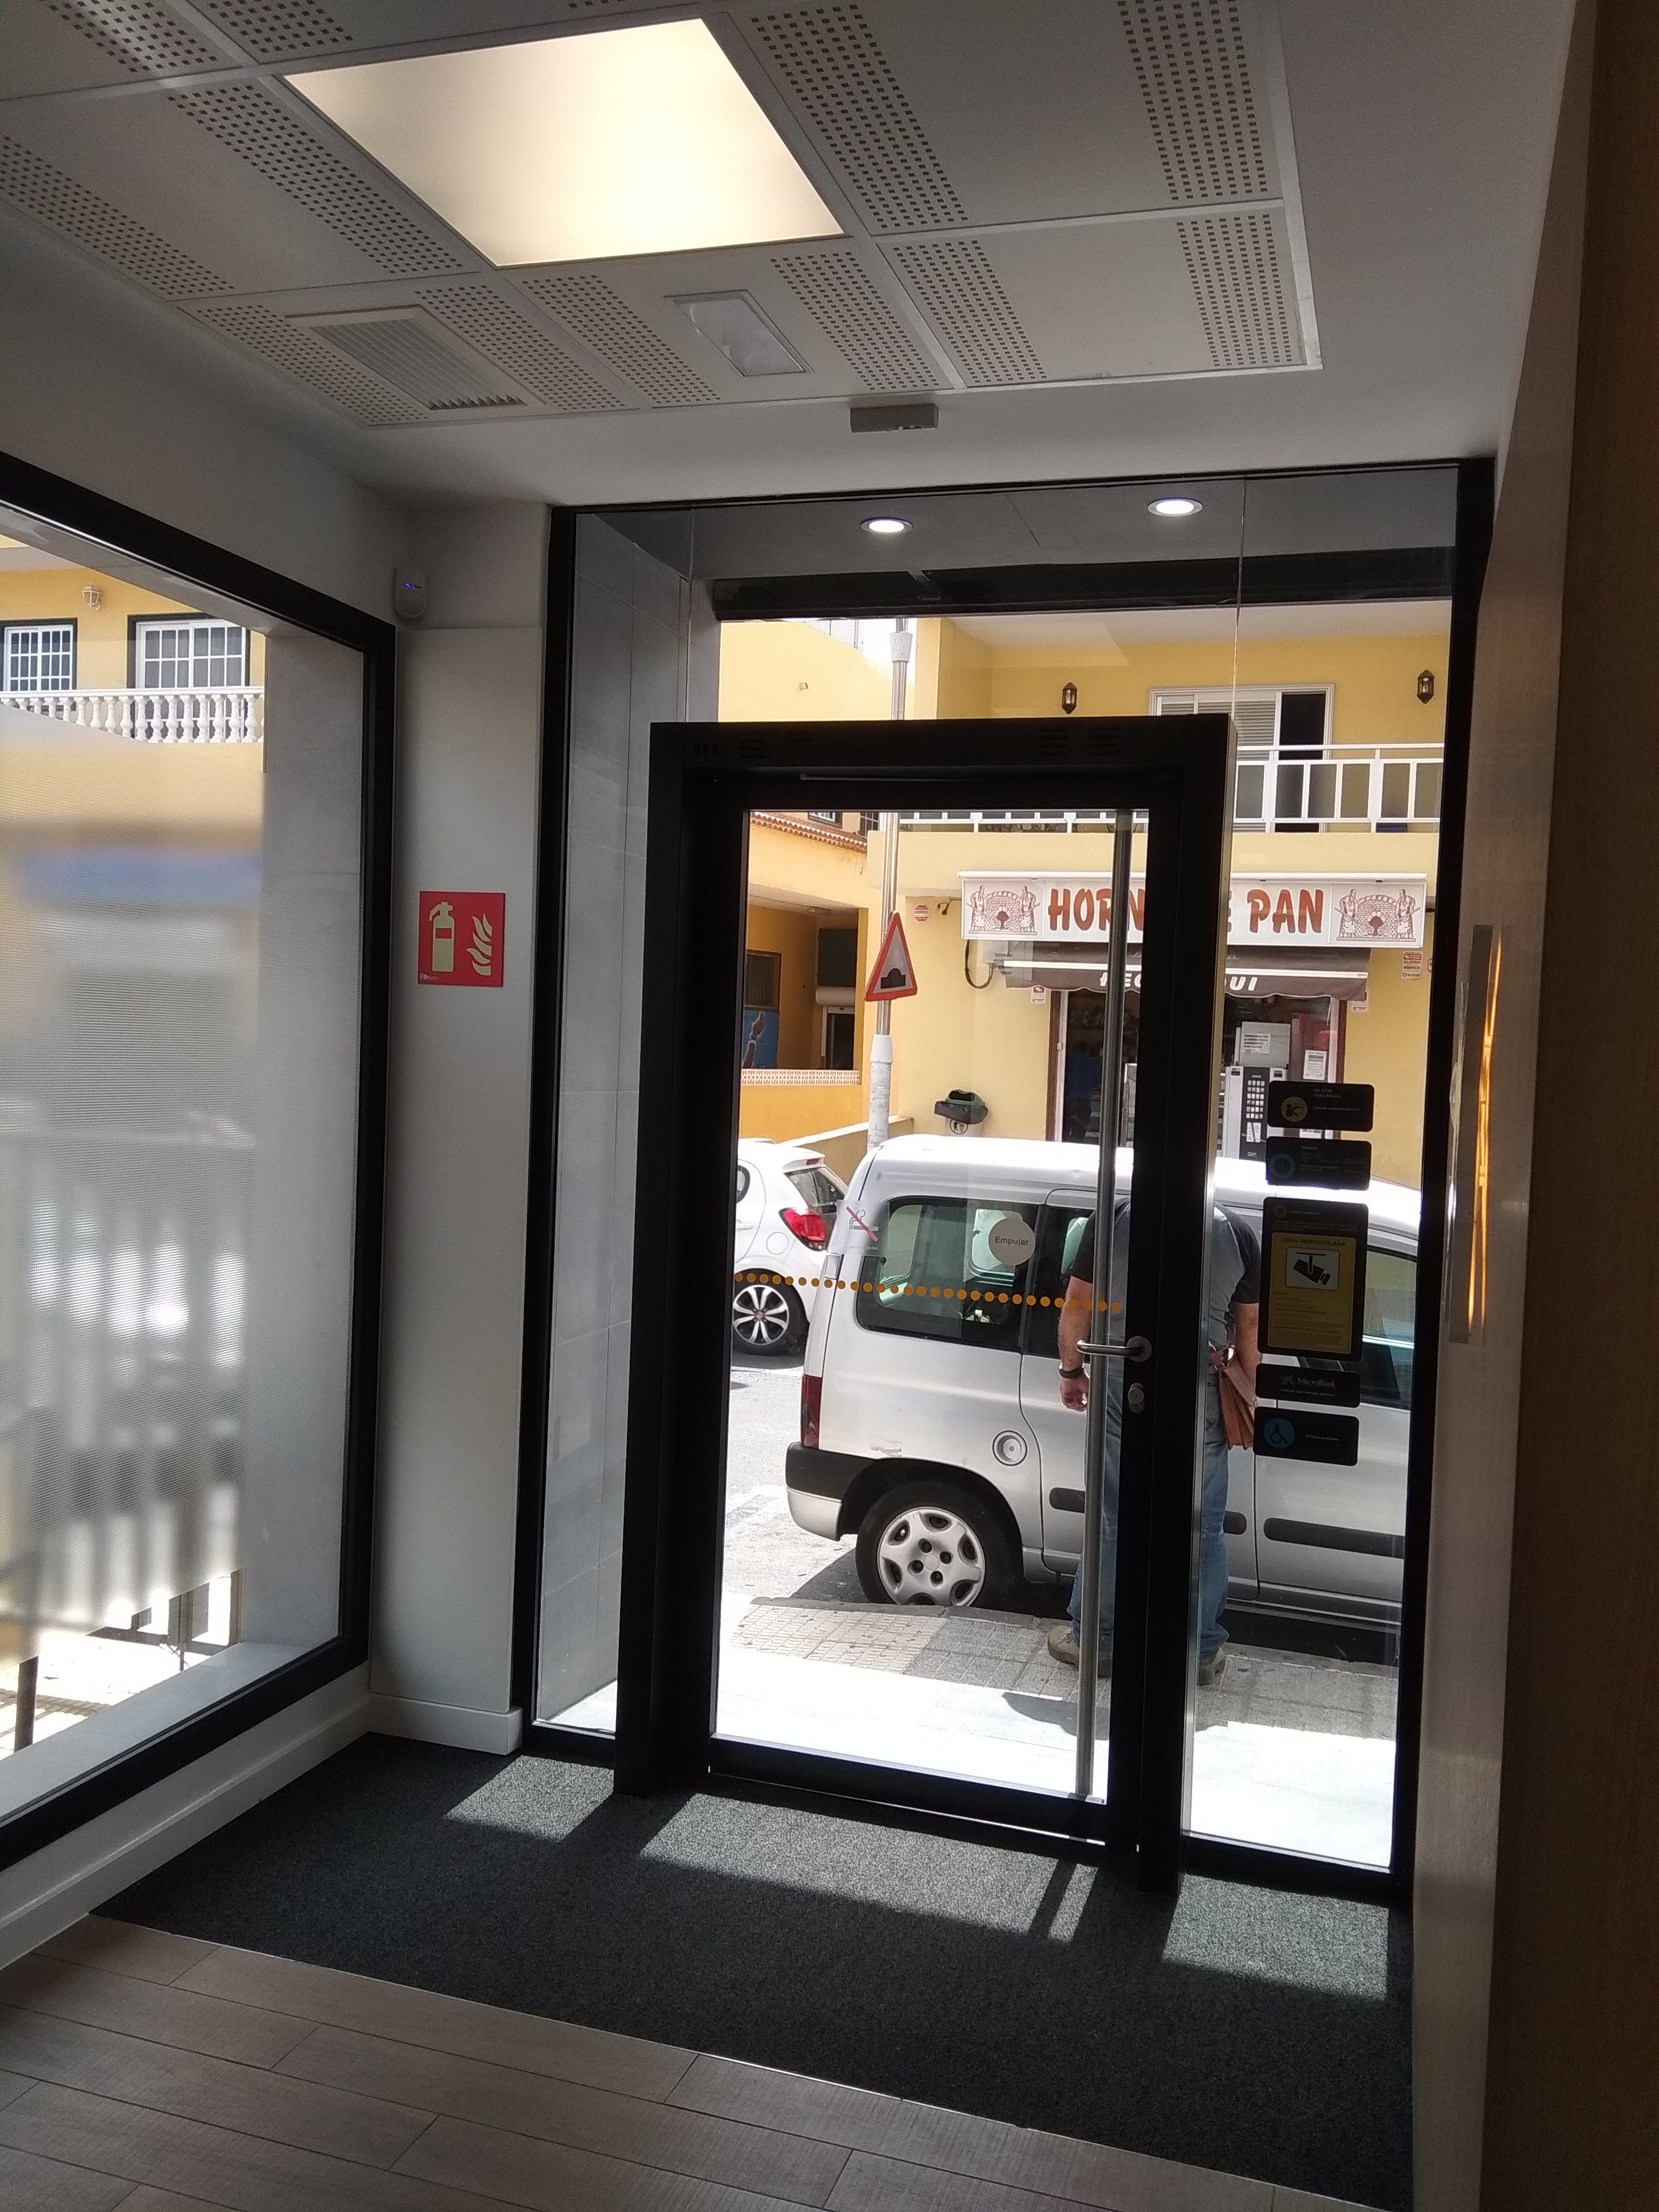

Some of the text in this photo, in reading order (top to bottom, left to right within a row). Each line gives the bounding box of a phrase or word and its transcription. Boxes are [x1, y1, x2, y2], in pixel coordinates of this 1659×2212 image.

[1048, 888, 1145, 932] HORN
[1247, 889, 1323, 934] PAN
[995, 1236, 1029, 1246] Empujar
[1297, 1377, 1336, 1387] MicroBank
